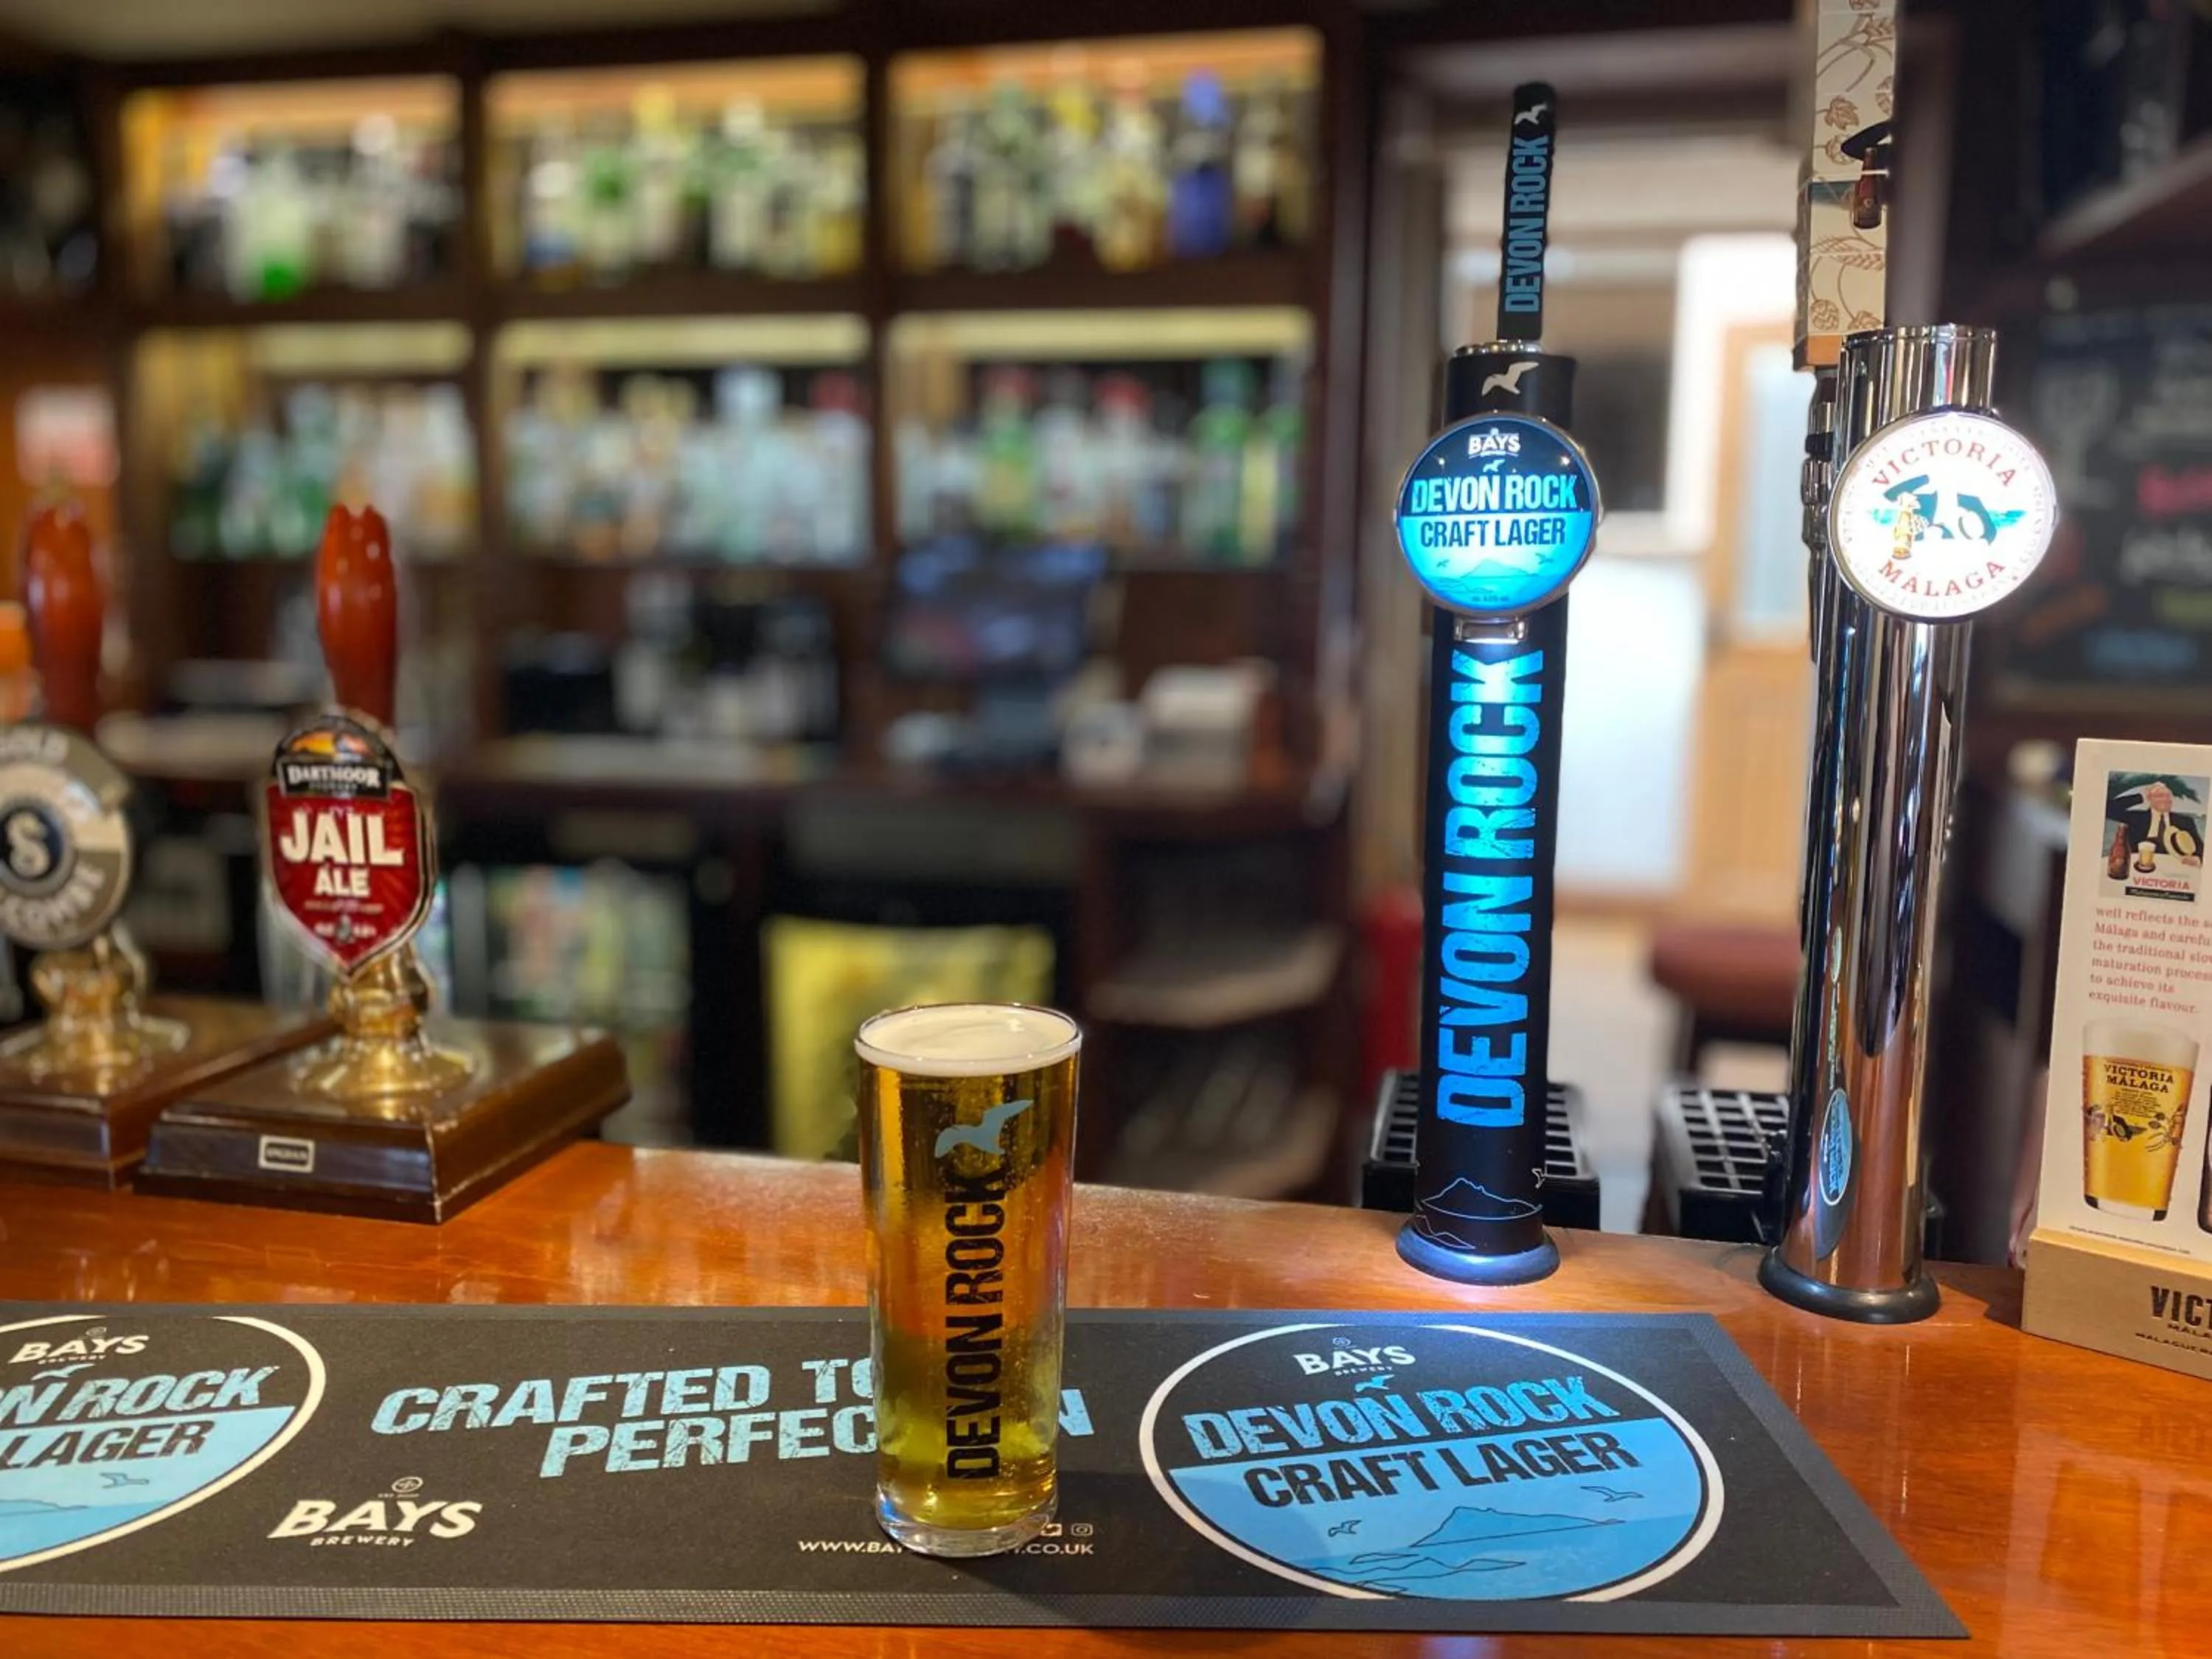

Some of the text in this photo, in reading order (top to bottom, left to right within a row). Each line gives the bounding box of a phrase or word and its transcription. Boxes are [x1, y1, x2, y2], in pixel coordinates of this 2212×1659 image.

[1505, 134, 1548, 313] DEVON ROCK
[1468, 434, 1521, 455] BAYS
[1872, 438, 2016, 487] VICTORIA
[1411, 473, 1577, 513] DEVON ROCK
[1420, 518, 1566, 548] CRAFT LAGER
[279, 809, 404, 866] JAIL
[314, 867, 371, 897] ALE
[1436, 649, 1543, 1128] DEVON ROCK
[2132, 877, 2190, 890] VICTORIA
[2096, 908, 2121, 919] well
[2125, 910, 2174, 925] reflects
[2177, 915, 2199, 928] the
[2093, 939, 2113, 951] the
[2117, 943, 2185, 961] traditional
[2141, 930, 2166, 941] and
[2169, 933, 2212, 947] carefu
[2091, 957, 2162, 975] maturation
[2090, 973, 2175, 993] to achieve its
[2088, 991, 2147, 1006] exquisite
[2104, 1063, 2174, 1084] VICTORIA
[945, 1165, 1007, 1481] DEVON ROCK
[8, 1335, 150, 1364] BAYS
[1293, 1346, 1416, 1375] BAYS
[56, 1366, 281, 1422] ROCK
[371, 1365, 771, 1435] CRAFTED
[1182, 1374, 1621, 1459] DEVON ROCK
[0, 1419, 215, 1470] LAGER
[1243, 1430, 1641, 1508] CRAFT LAGER
[266, 1499, 484, 1539] BAYS
[310, 1534, 414, 1547] BREWERY
